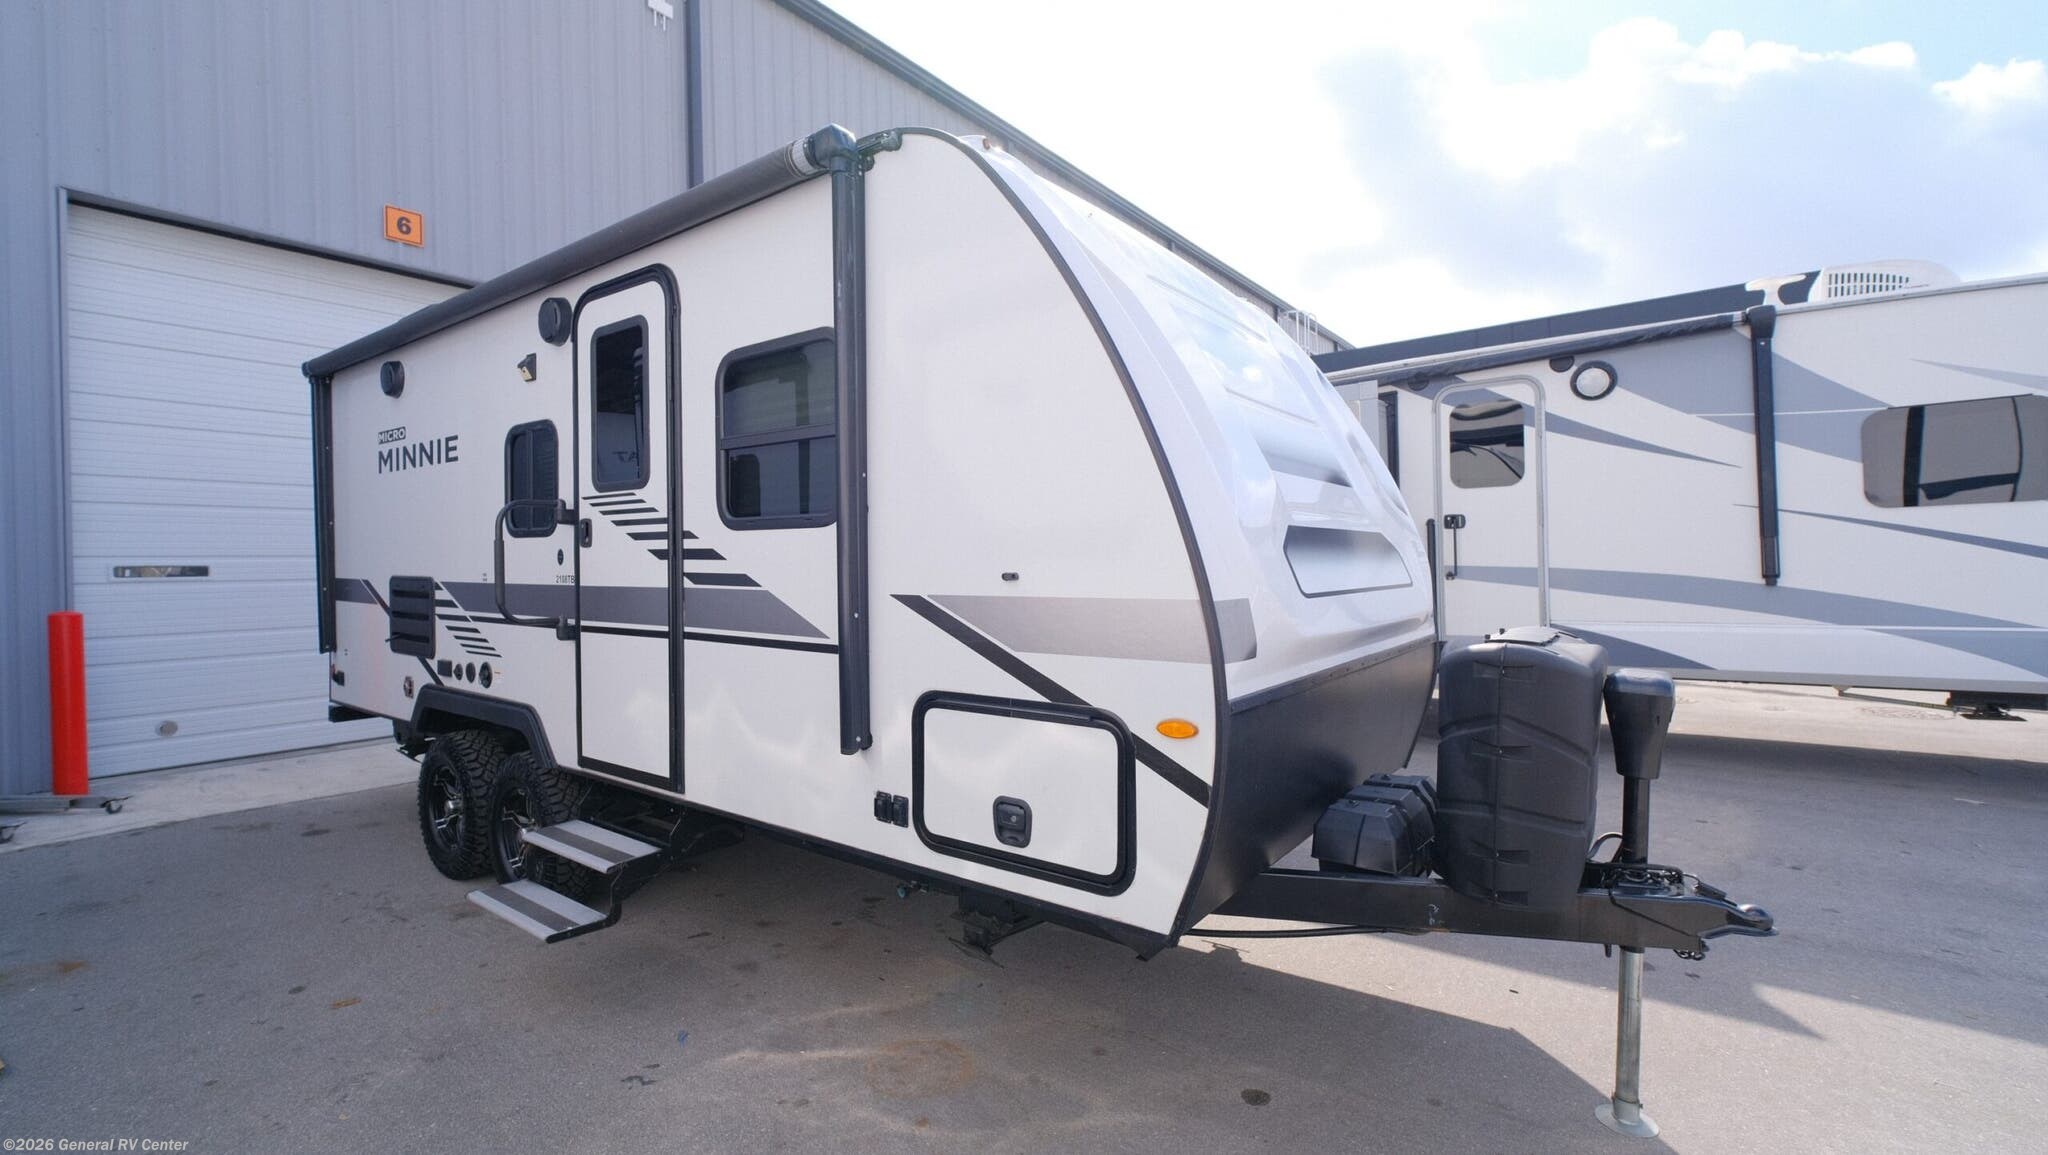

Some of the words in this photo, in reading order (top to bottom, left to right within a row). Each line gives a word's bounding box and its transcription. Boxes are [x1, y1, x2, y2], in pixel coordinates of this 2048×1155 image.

[397, 216, 412, 235] 6
[378, 427, 406, 444] MICRO
[378, 434, 459, 474] MINNIE
